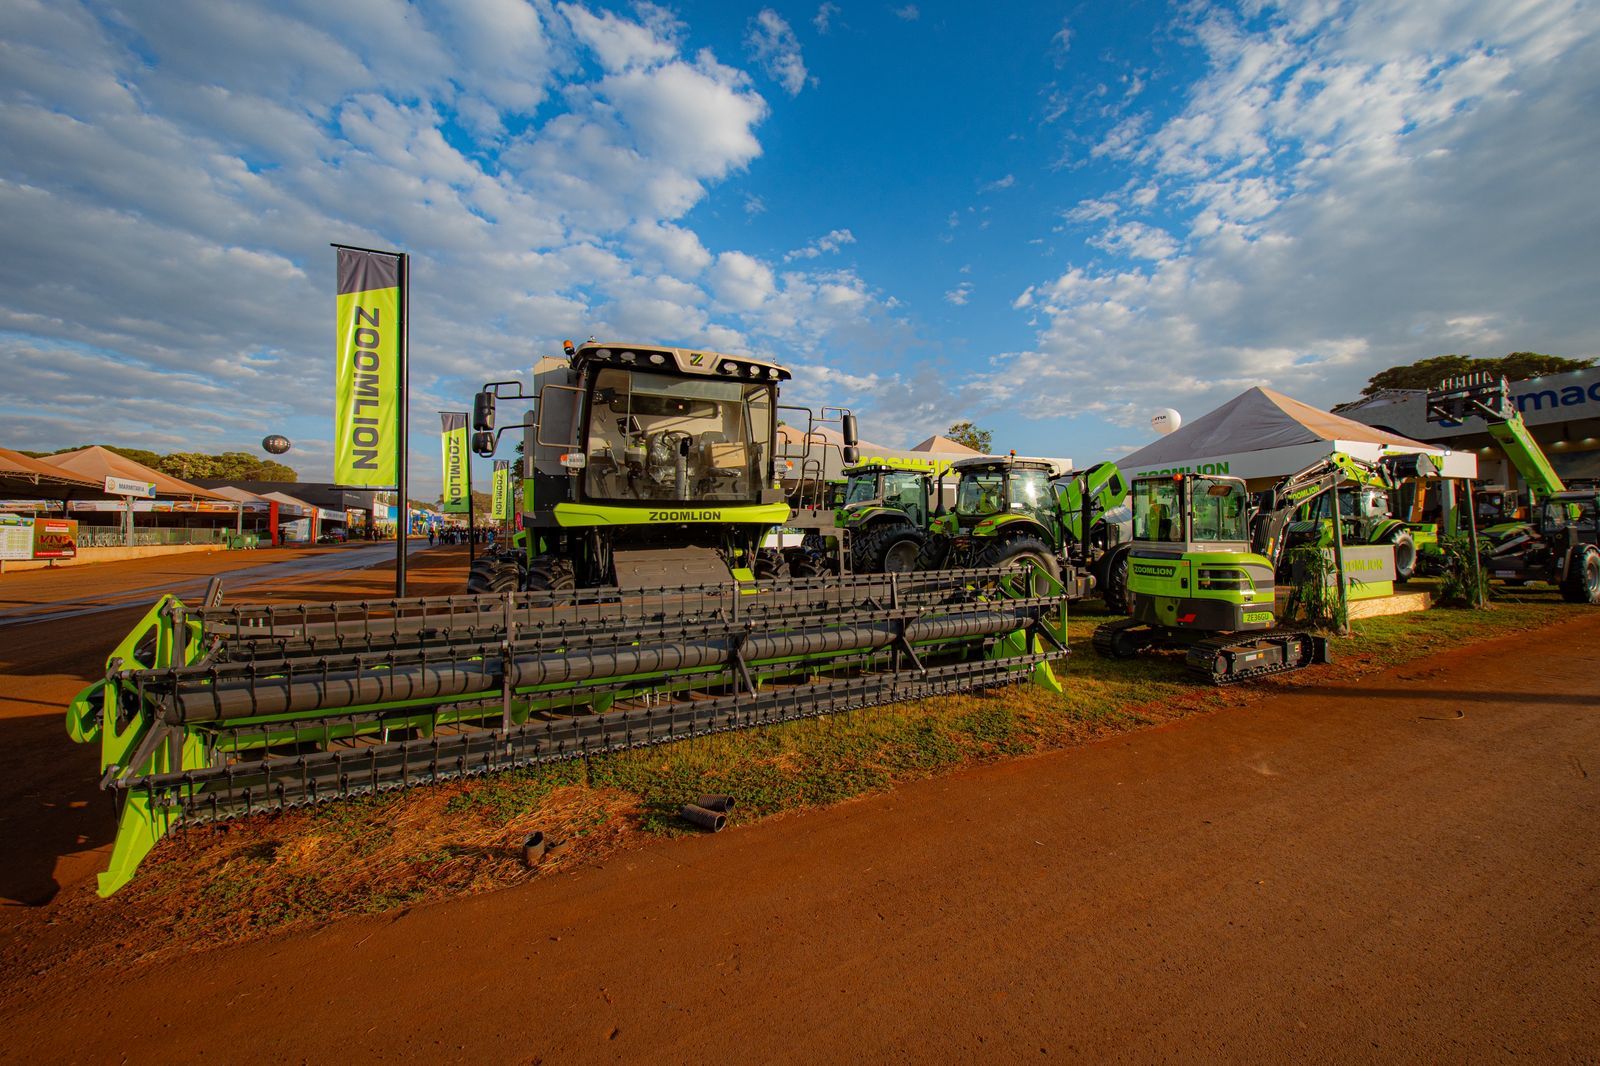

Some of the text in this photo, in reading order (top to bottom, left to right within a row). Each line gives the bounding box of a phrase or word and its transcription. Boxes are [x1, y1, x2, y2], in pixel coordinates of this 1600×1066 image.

[352, 306, 379, 469] ZOOMLION
[449, 437, 461, 505] ZOOMLION
[649, 511, 721, 521] ZOOMLION
[1134, 566, 1173, 576] ZOOMLION
